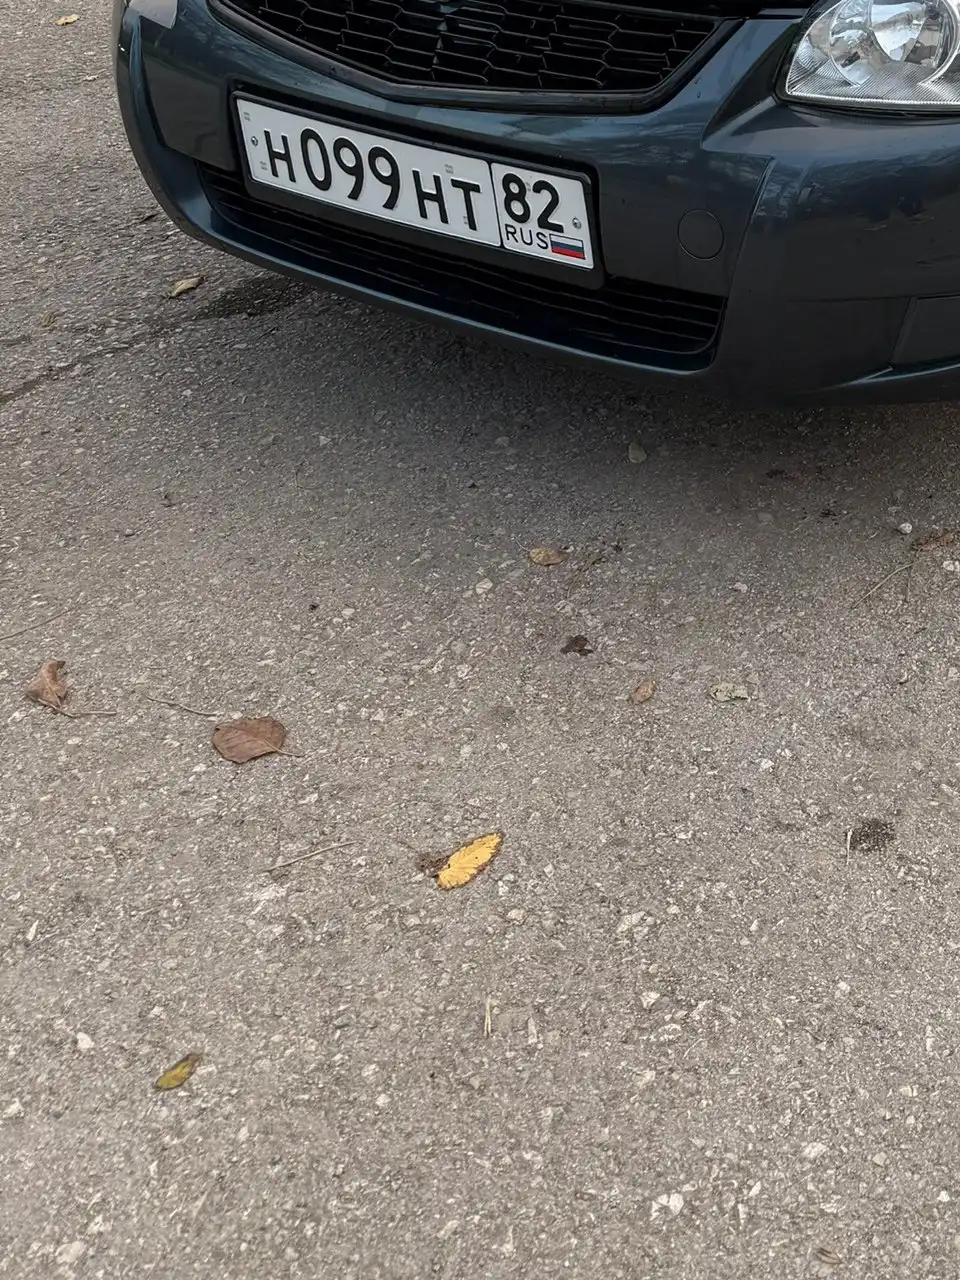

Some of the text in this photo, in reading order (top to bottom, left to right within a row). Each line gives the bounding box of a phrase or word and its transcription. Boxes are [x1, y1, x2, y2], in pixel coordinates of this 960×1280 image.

[264, 127, 564, 233] Н099НТ 82
[505, 224, 549, 250] RUS
